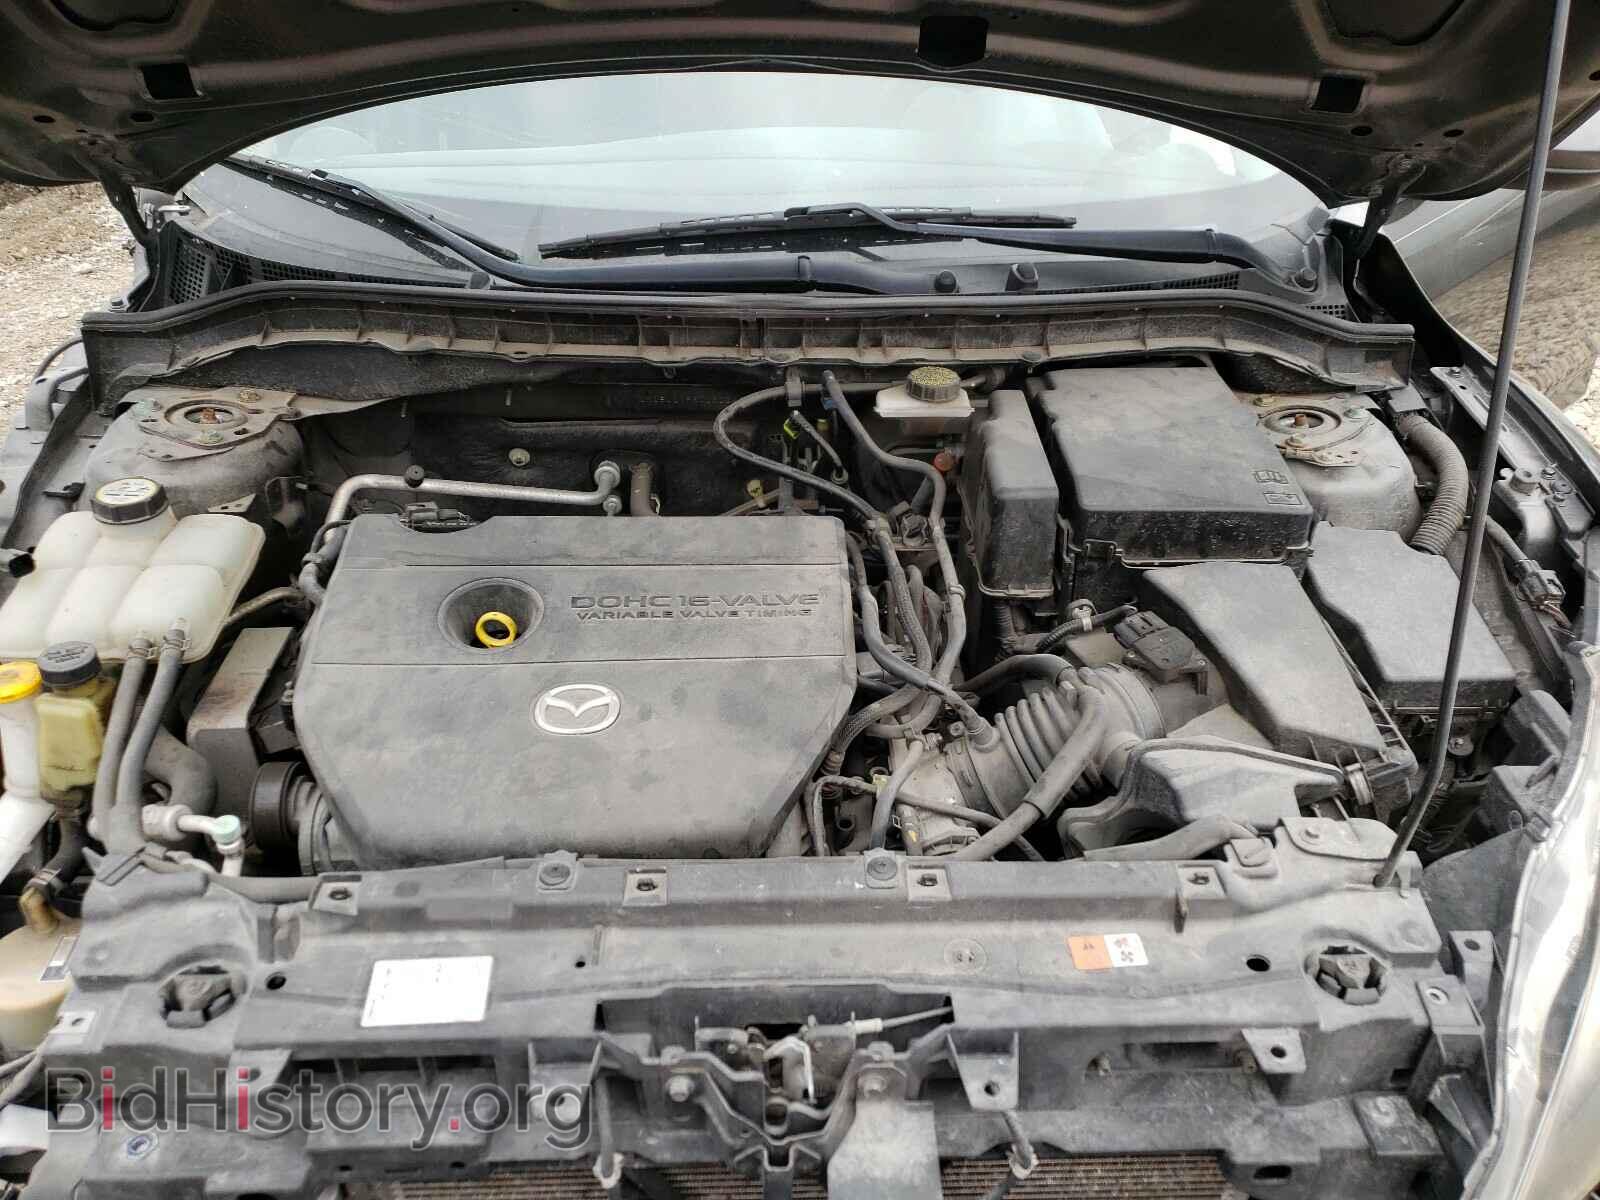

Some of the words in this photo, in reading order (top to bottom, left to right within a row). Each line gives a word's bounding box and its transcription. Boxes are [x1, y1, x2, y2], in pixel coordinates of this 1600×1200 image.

[570, 595, 673, 609] DOHC
[676, 593, 820, 608] 16-VALVE
[576, 610, 675, 620] VARIABLE
[679, 609, 739, 618] VALVE
[743, 608, 813, 618] TIMING
